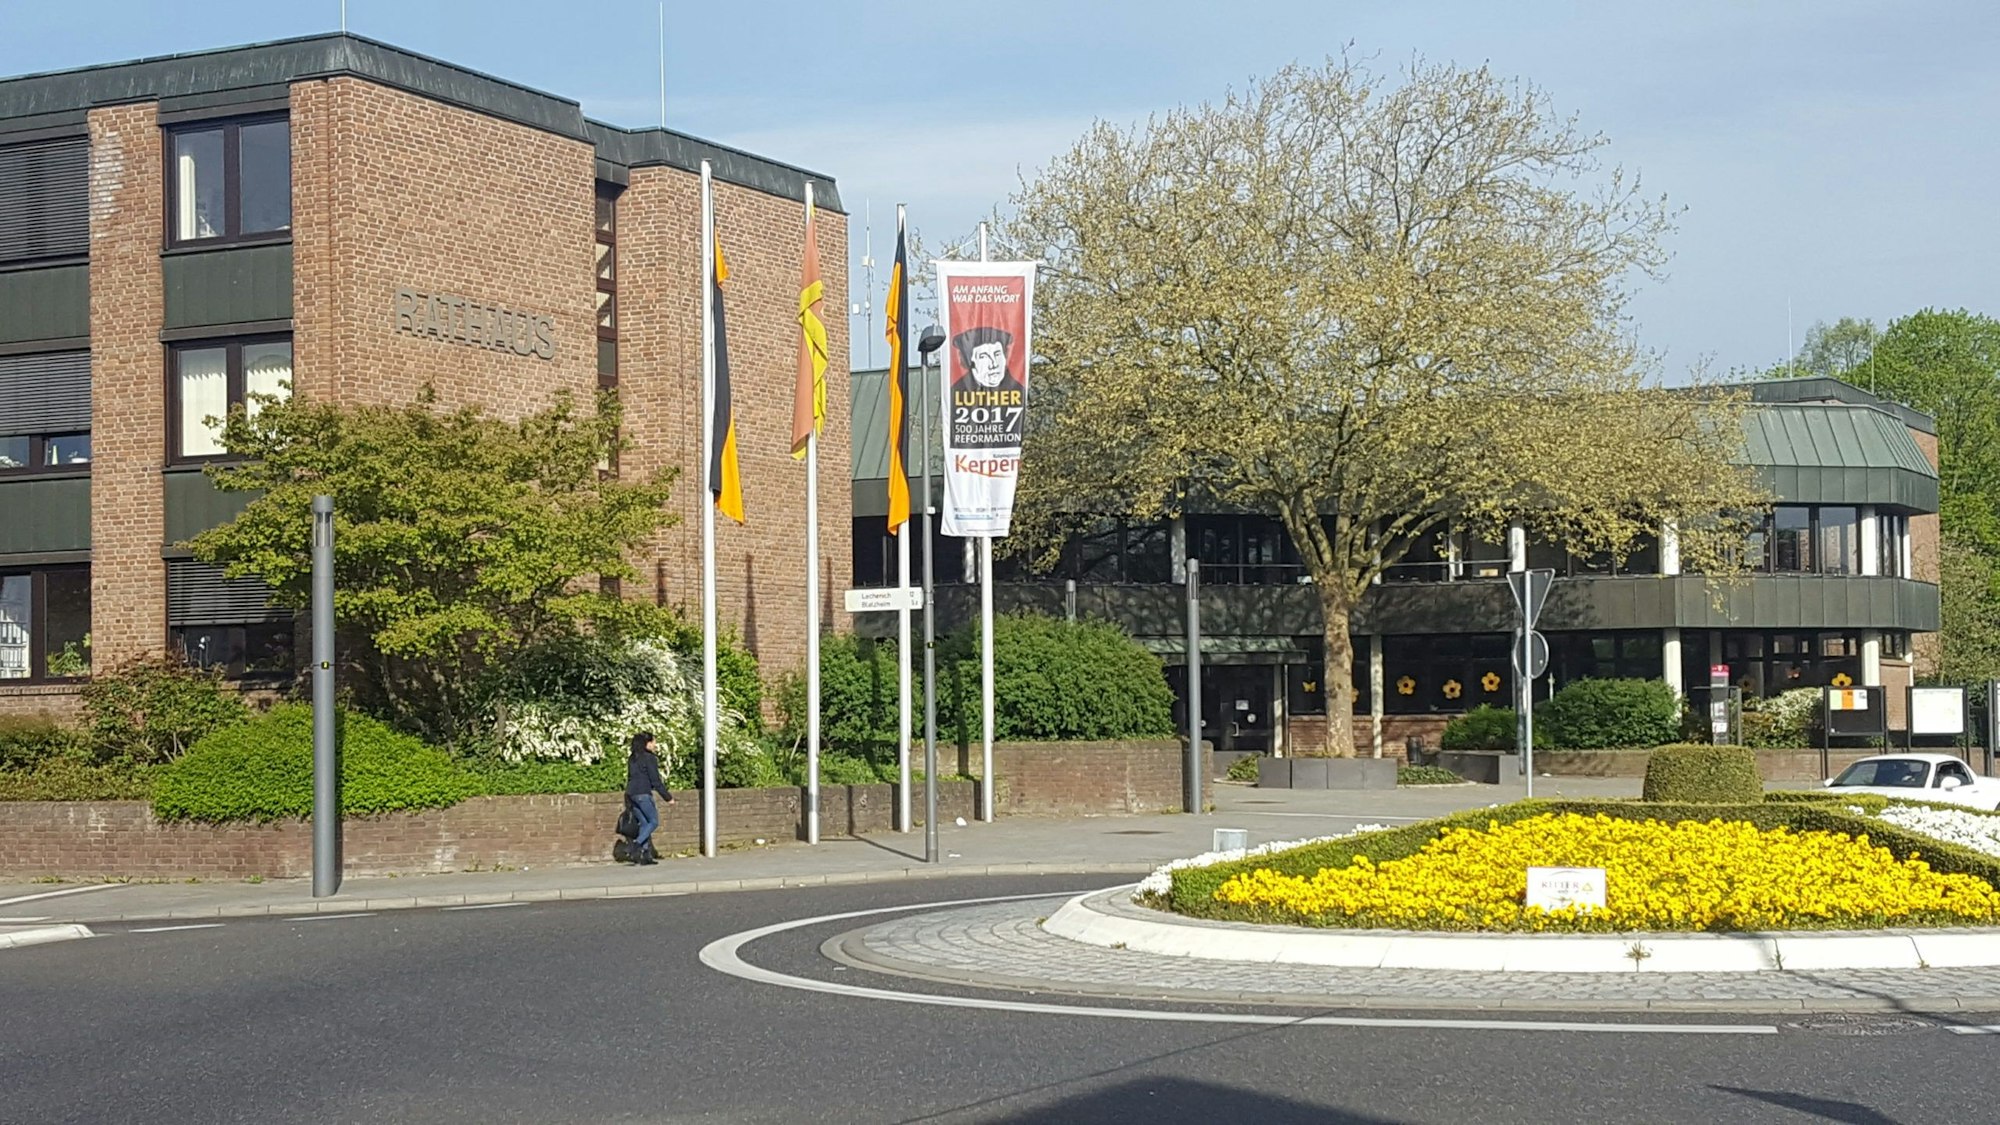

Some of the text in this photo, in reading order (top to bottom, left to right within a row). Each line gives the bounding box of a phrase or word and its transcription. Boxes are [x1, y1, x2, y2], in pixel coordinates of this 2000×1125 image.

[953, 285, 1008, 294] AM ANFANG
[952, 294, 1020, 303] WAR DAS WORT
[395, 287, 556, 360] RATHAUS
[955, 390, 1021, 406] LUTHER
[954, 407, 1024, 432] 2017
[955, 424, 1004, 434] 500 JAHRE
[954, 433, 1022, 443] REFORMATION
[955, 454, 1022, 477] Kerpen
